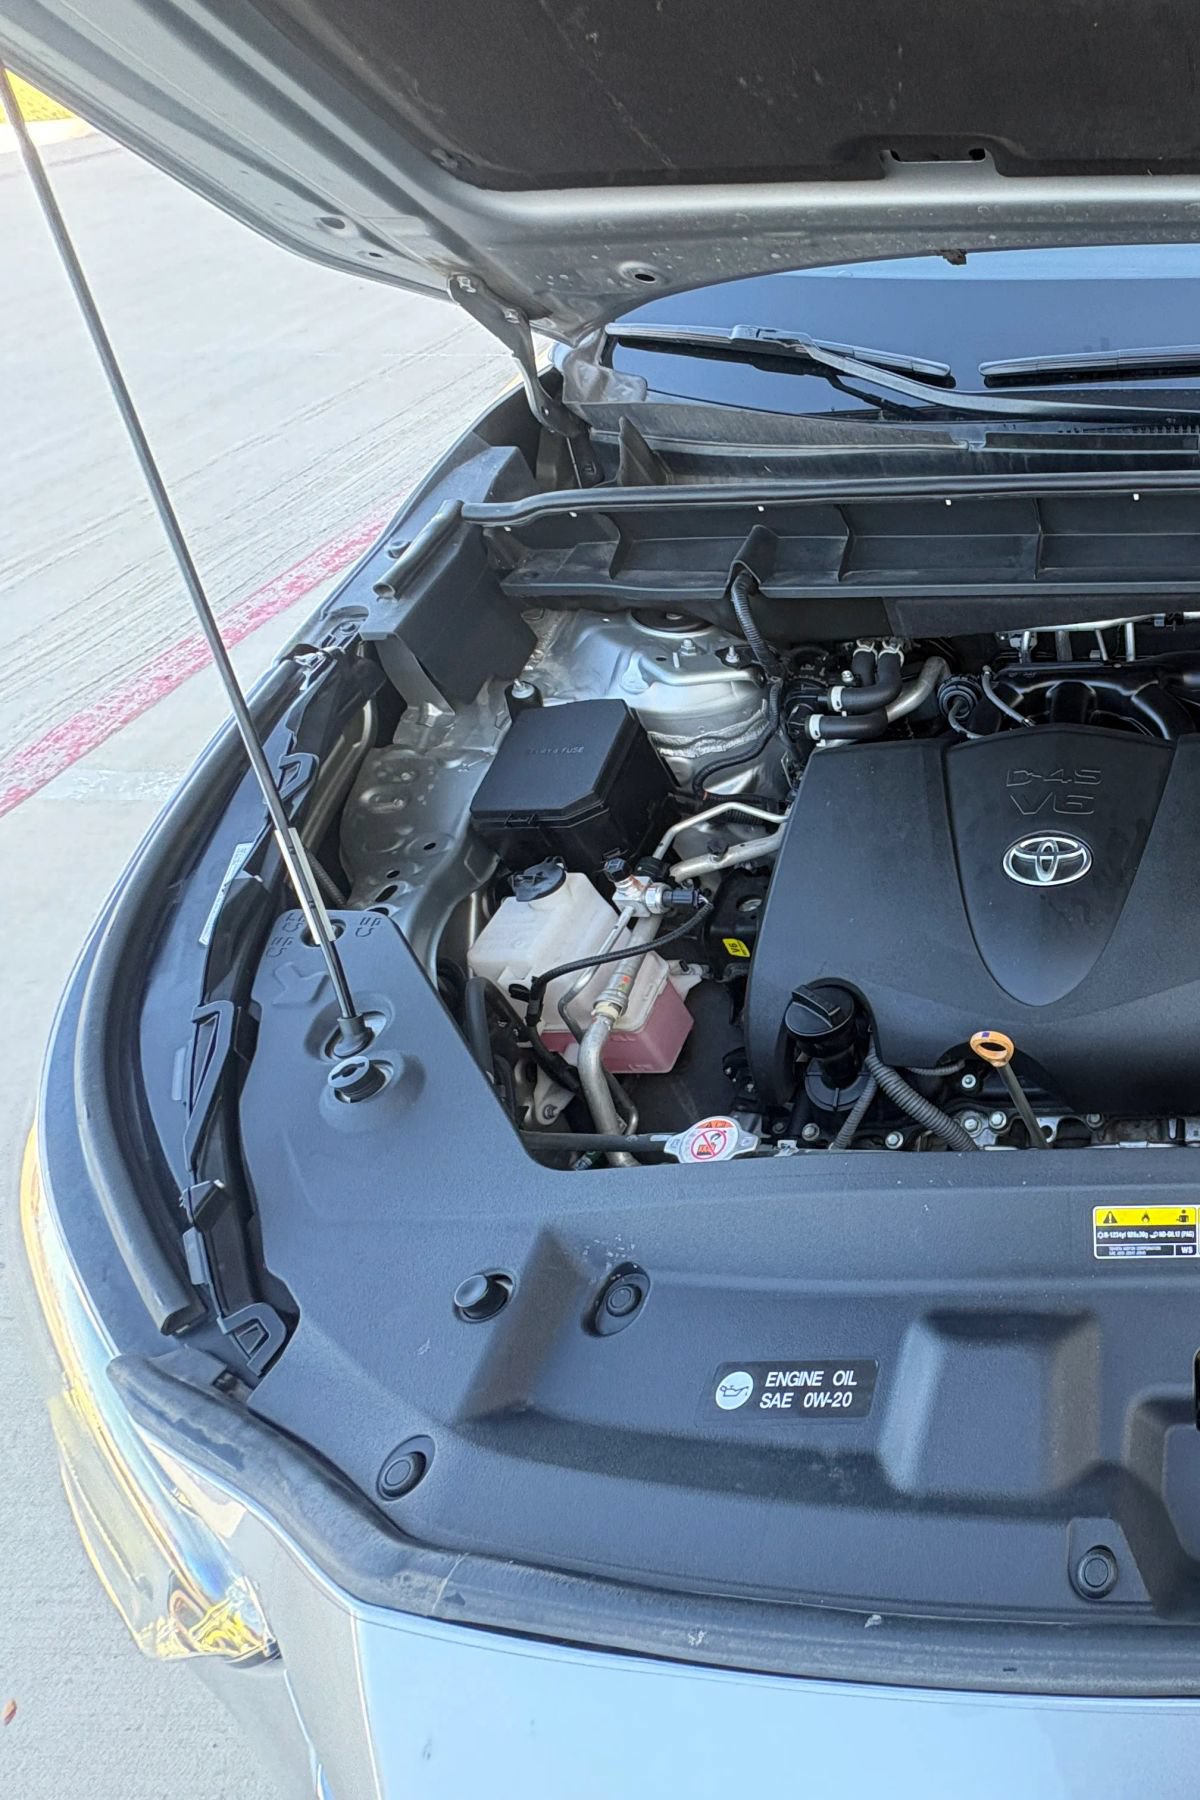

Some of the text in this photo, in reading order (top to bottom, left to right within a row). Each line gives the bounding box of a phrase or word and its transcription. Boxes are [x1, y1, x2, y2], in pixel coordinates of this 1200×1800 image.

[1006, 768, 1101, 787] D-4S
[1009, 791, 1095, 816] V6
[765, 1370, 857, 1387] ENGINE OIL
[759, 1391, 853, 1409] SAE 0W-20
